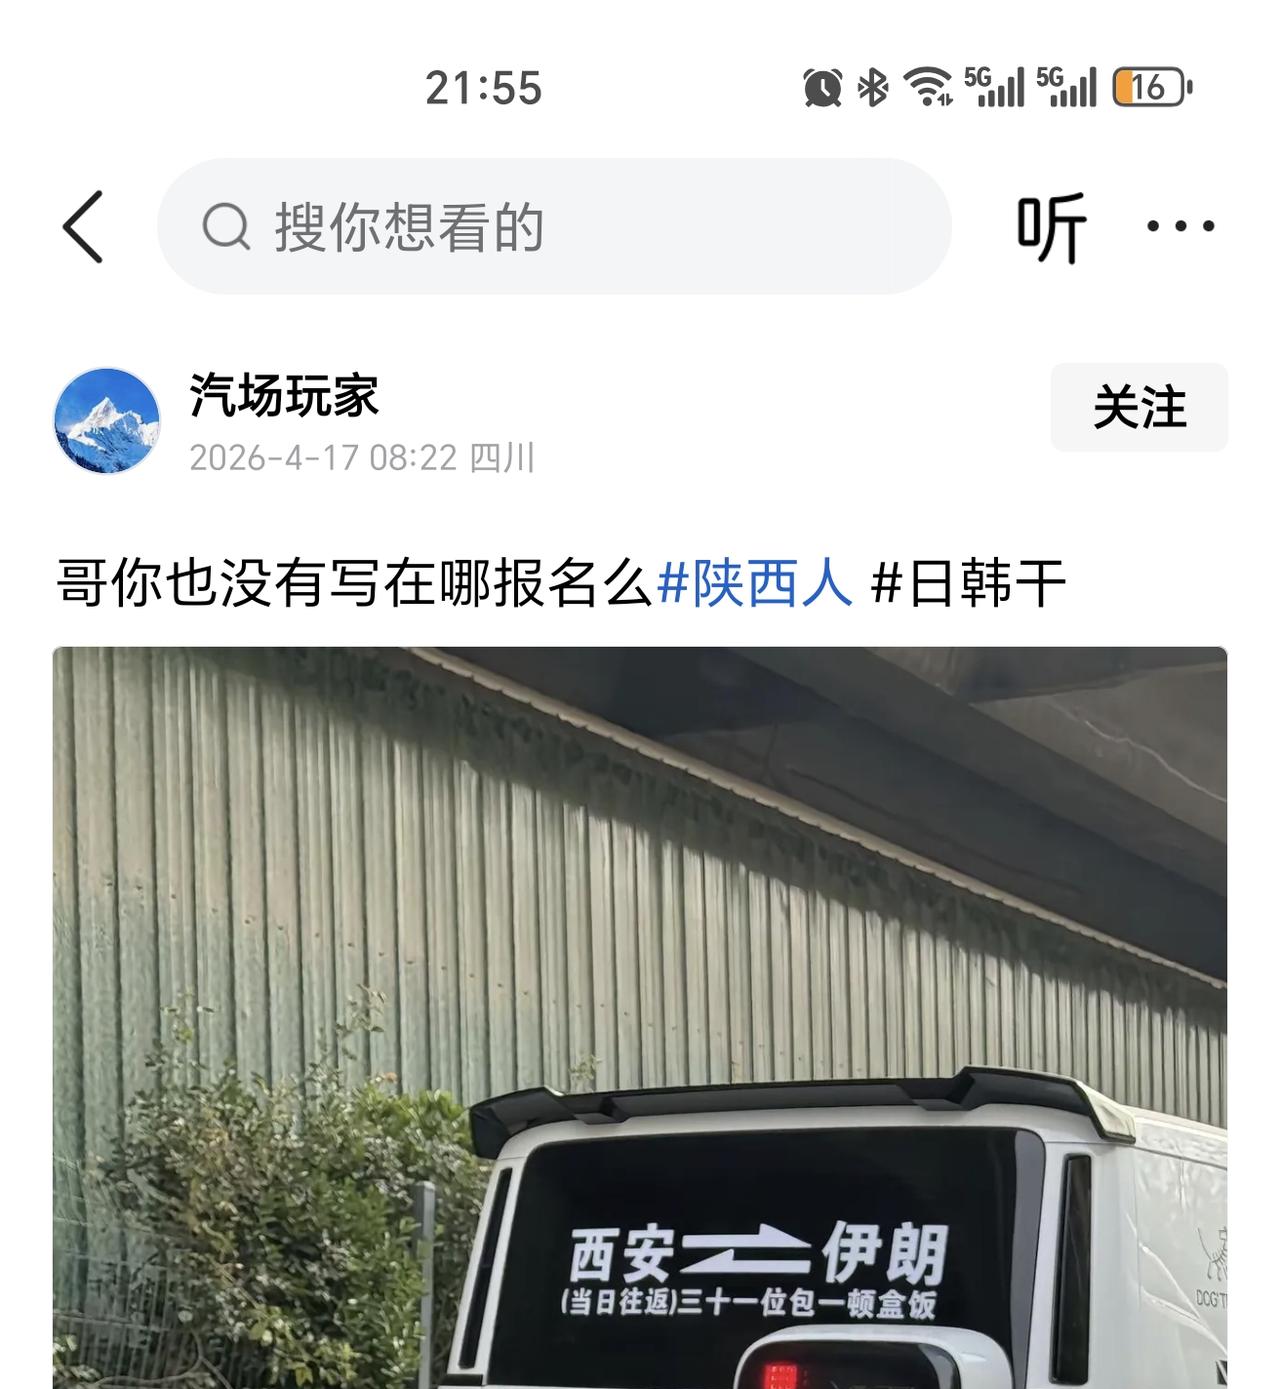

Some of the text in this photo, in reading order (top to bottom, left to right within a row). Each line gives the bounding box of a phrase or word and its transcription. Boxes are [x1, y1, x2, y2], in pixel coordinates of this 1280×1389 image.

[426, 69, 542, 106] 21:55
[964, 66, 992, 87] 5G
[1036, 66, 1064, 87] 5G
[1132, 74, 1165, 100] 16
[275, 201, 543, 254] 搜你想看的
[1017, 191, 1088, 266] 听
[189, 370, 380, 419] 汽场玩家
[1093, 382, 1188, 430] 关注
[190, 441, 534, 474] 2026-4-17 08:22 四川
[871, 556, 1067, 609] #日韩干
[570, 1220, 949, 1286] 西安 伊朗
